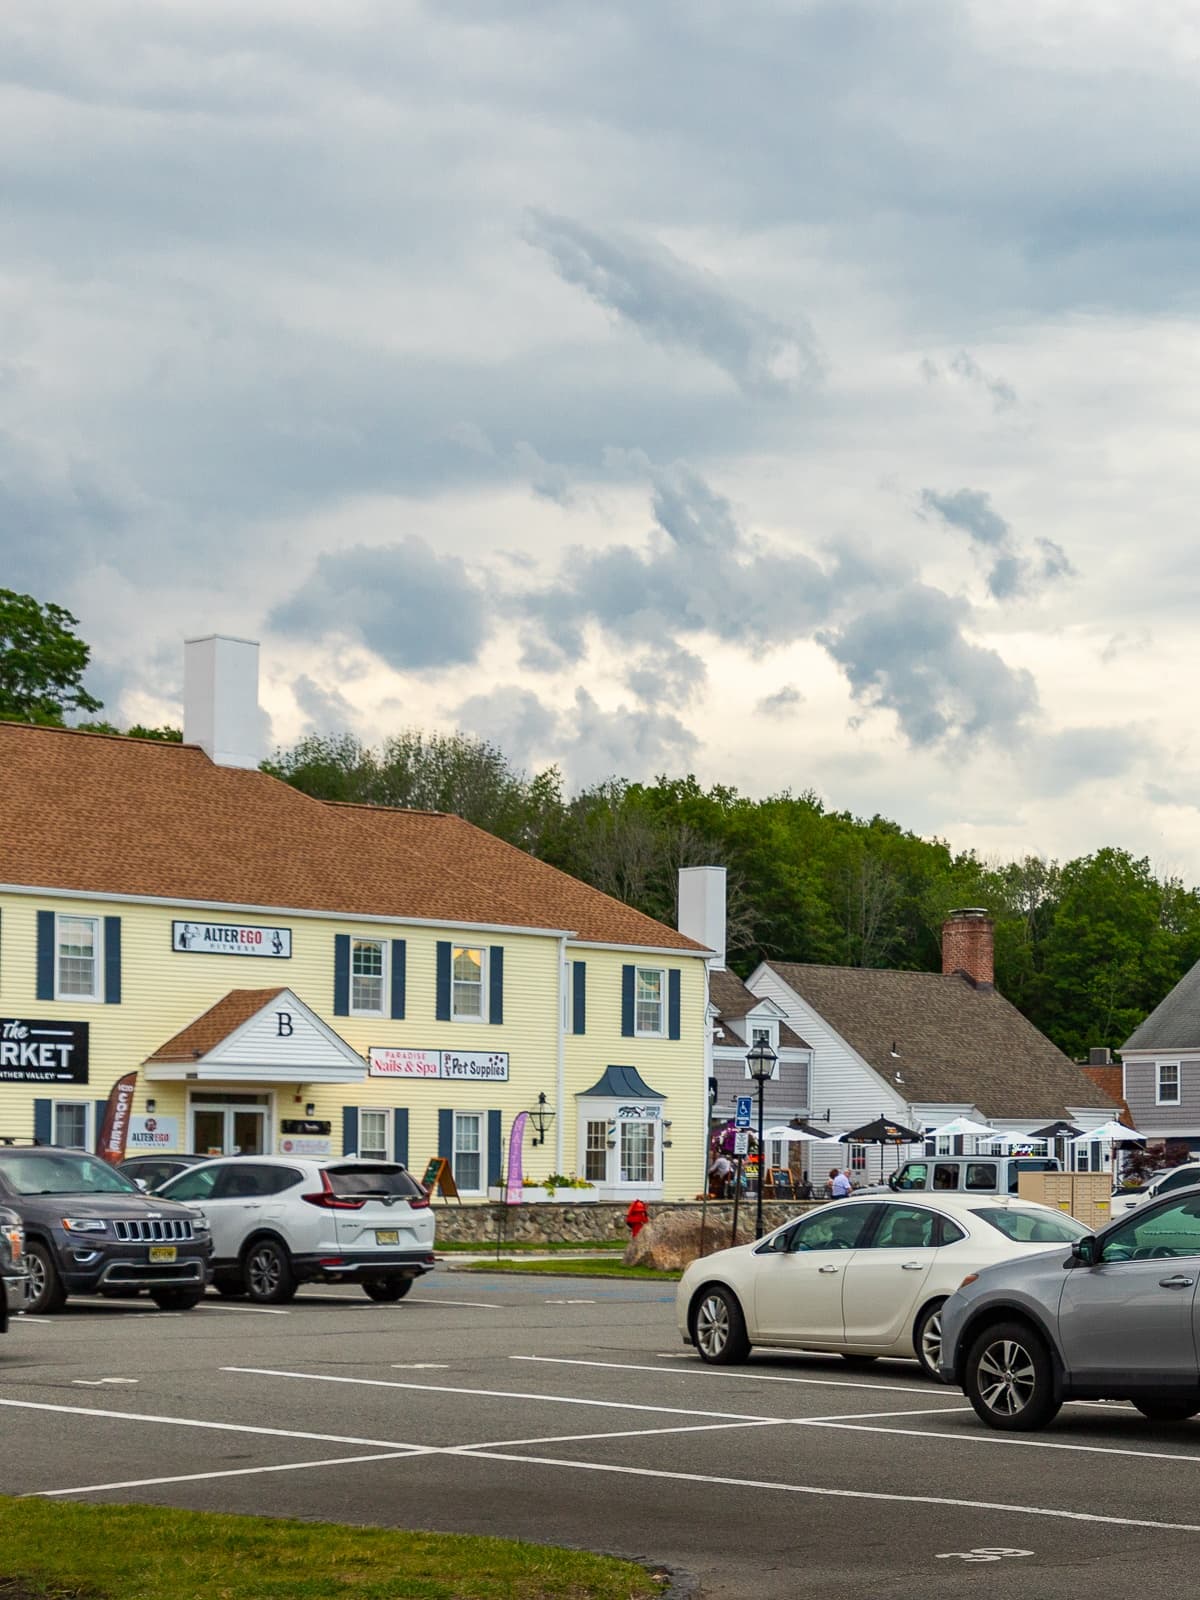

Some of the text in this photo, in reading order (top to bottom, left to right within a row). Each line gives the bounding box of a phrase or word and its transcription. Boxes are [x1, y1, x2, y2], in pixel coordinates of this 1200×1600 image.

[3, 1020, 30, 1040] The
[275, 1012, 293, 1037] B
[0, 1042, 74, 1067] RKET
[25, 1072, 55, 1080] VALLEY
[374, 1059, 402, 1073] Nails
[405, 1062, 413, 1073] &
[416, 1061, 437, 1075] Spa
[452, 1058, 468, 1075] Pet
[470, 1061, 505, 1077] Supplies
[935, 1547, 1035, 1562] 39
